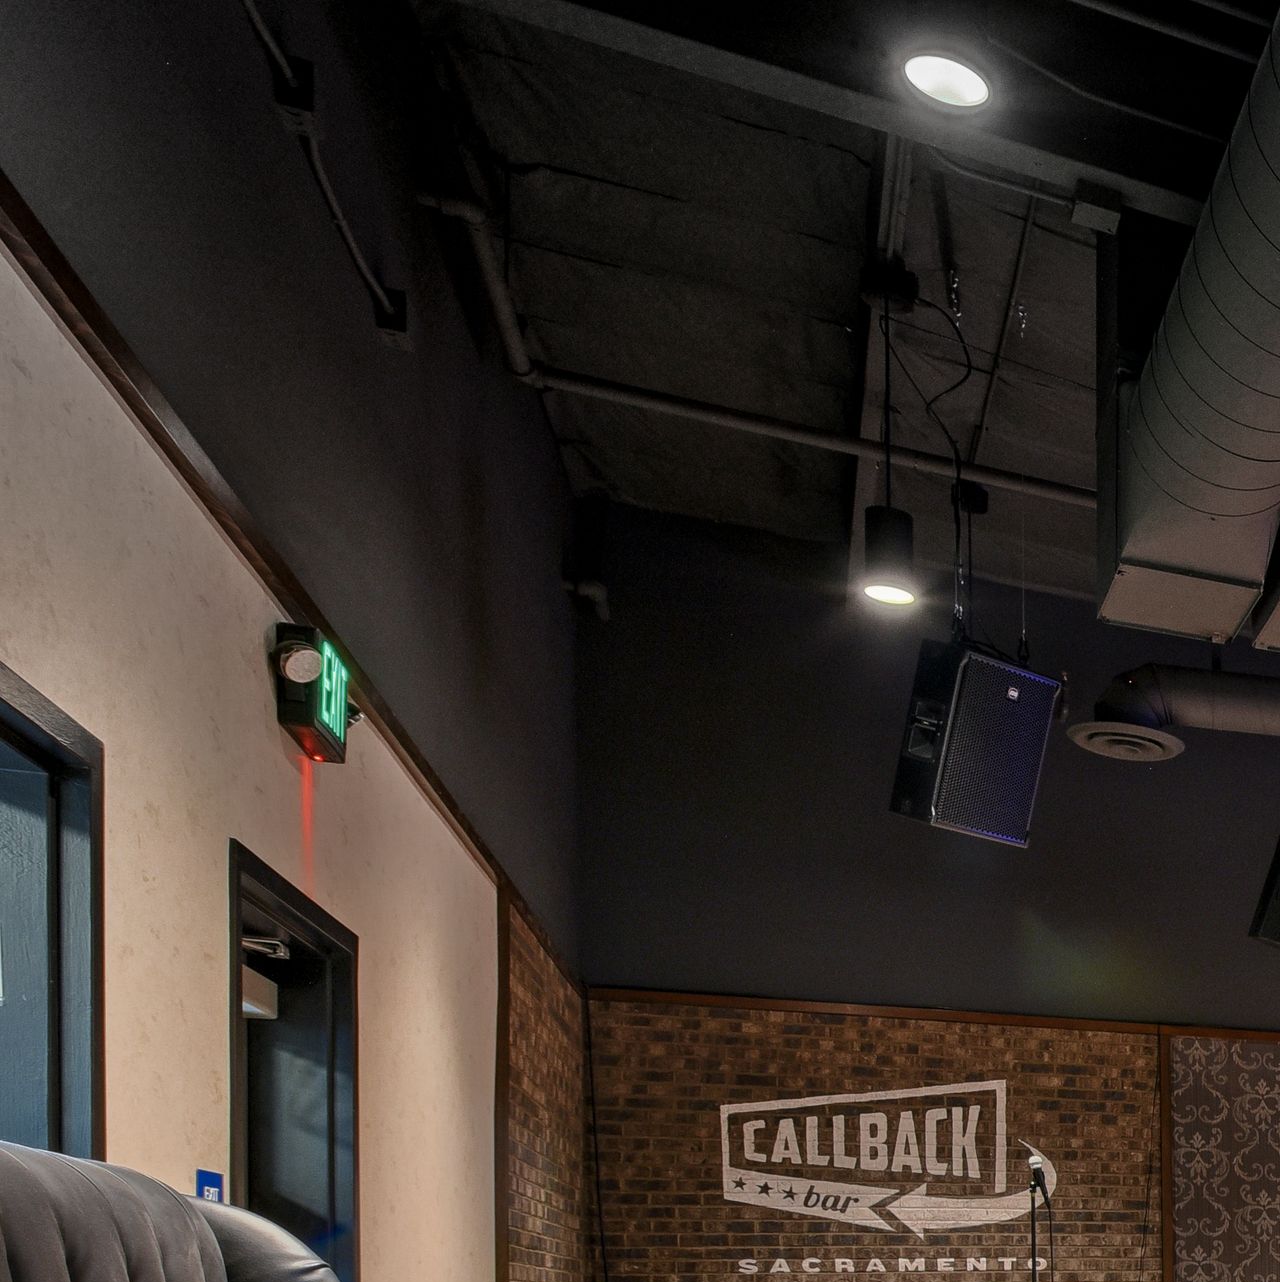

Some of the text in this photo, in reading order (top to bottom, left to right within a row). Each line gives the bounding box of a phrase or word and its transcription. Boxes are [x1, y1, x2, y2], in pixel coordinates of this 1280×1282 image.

[322, 640, 348, 743] EXIT
[743, 1105, 981, 1179] CALLBACK
[803, 1185, 861, 1214] bar
[738, 1257, 1048, 1275] SACRAMENTO
